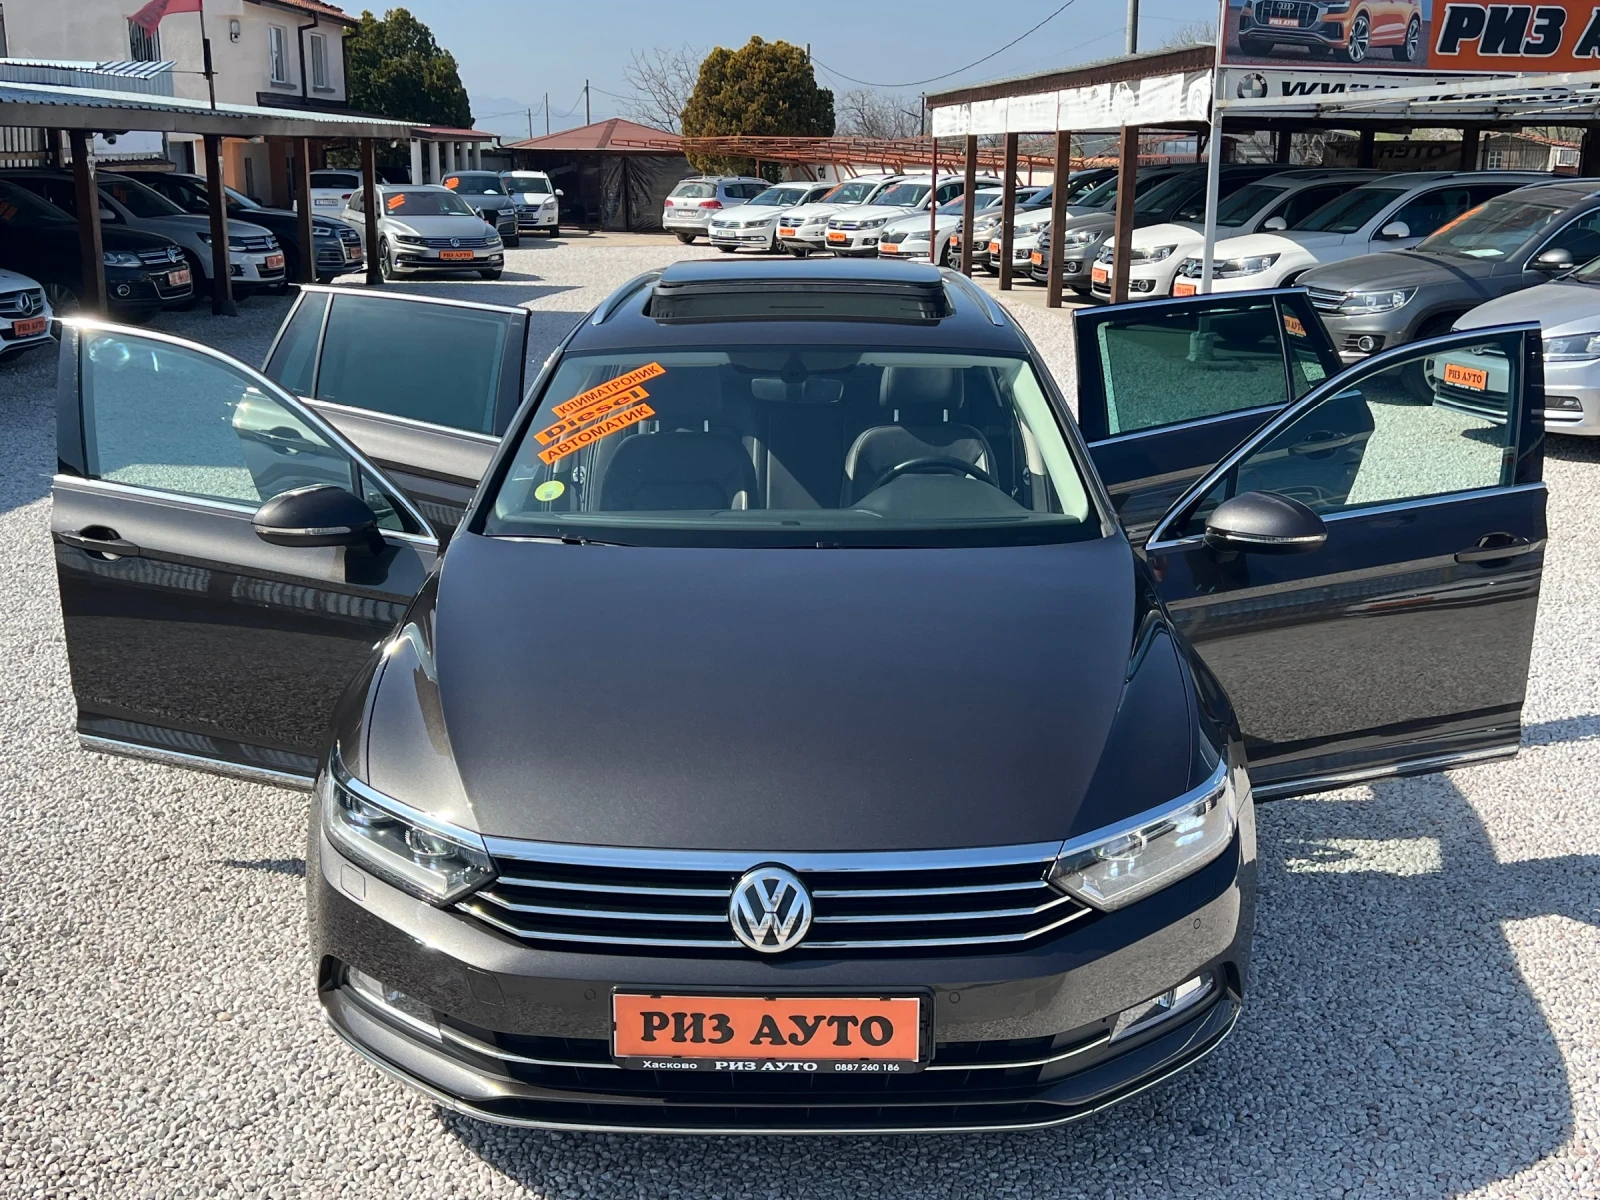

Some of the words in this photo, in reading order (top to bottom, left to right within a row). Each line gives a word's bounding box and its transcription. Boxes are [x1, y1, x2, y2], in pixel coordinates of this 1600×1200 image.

[1436, 4, 1567, 57] РИЗ
[560, 366, 659, 414] КЛИМАТРОНИК
[1448, 369, 1461, 380] РИЗ
[1462, 371, 1482, 383] АУТО
[544, 390, 640, 438] Diesel
[547, 407, 649, 460] АВТОМАТИК
[640, 1011, 734, 1044] РИЗ
[750, 1014, 893, 1046] АУТО
[642, 1060, 697, 1069] Хасково
[715, 1061, 756, 1071] РИЗ
[761, 1061, 817, 1072] АУТО
[835, 1063, 858, 1072] 0887
[861, 1064, 879, 1072] 260
[883, 1064, 900, 1072] 186
